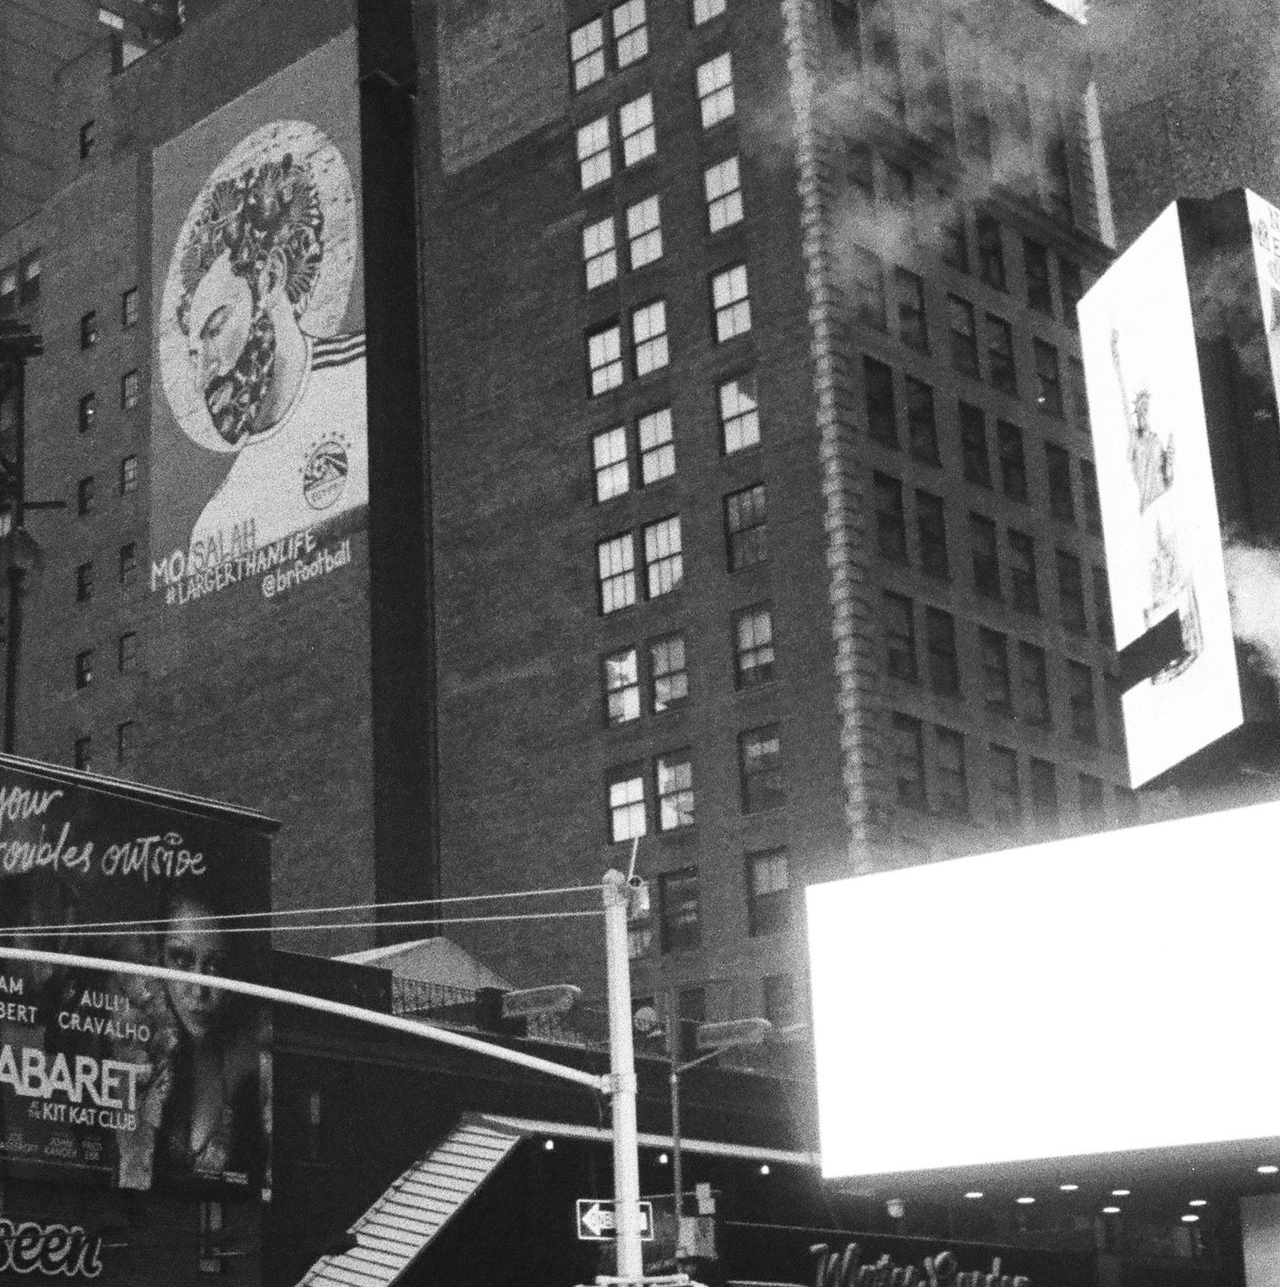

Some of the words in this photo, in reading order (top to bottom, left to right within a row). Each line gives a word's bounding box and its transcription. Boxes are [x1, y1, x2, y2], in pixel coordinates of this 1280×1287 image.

[150, 549, 185, 593] MO
[166, 525, 317, 605] #LARGERTHANLIFE
[261, 540, 351, 599] @brfootball
[101, 831, 208, 882] outside
[58, 1011, 151, 1042] CRAVALHO
[42, 1102, 67, 1122] KIT
[69, 1106, 96, 1126] KAT
[98, 1110, 137, 1132] CLUB
